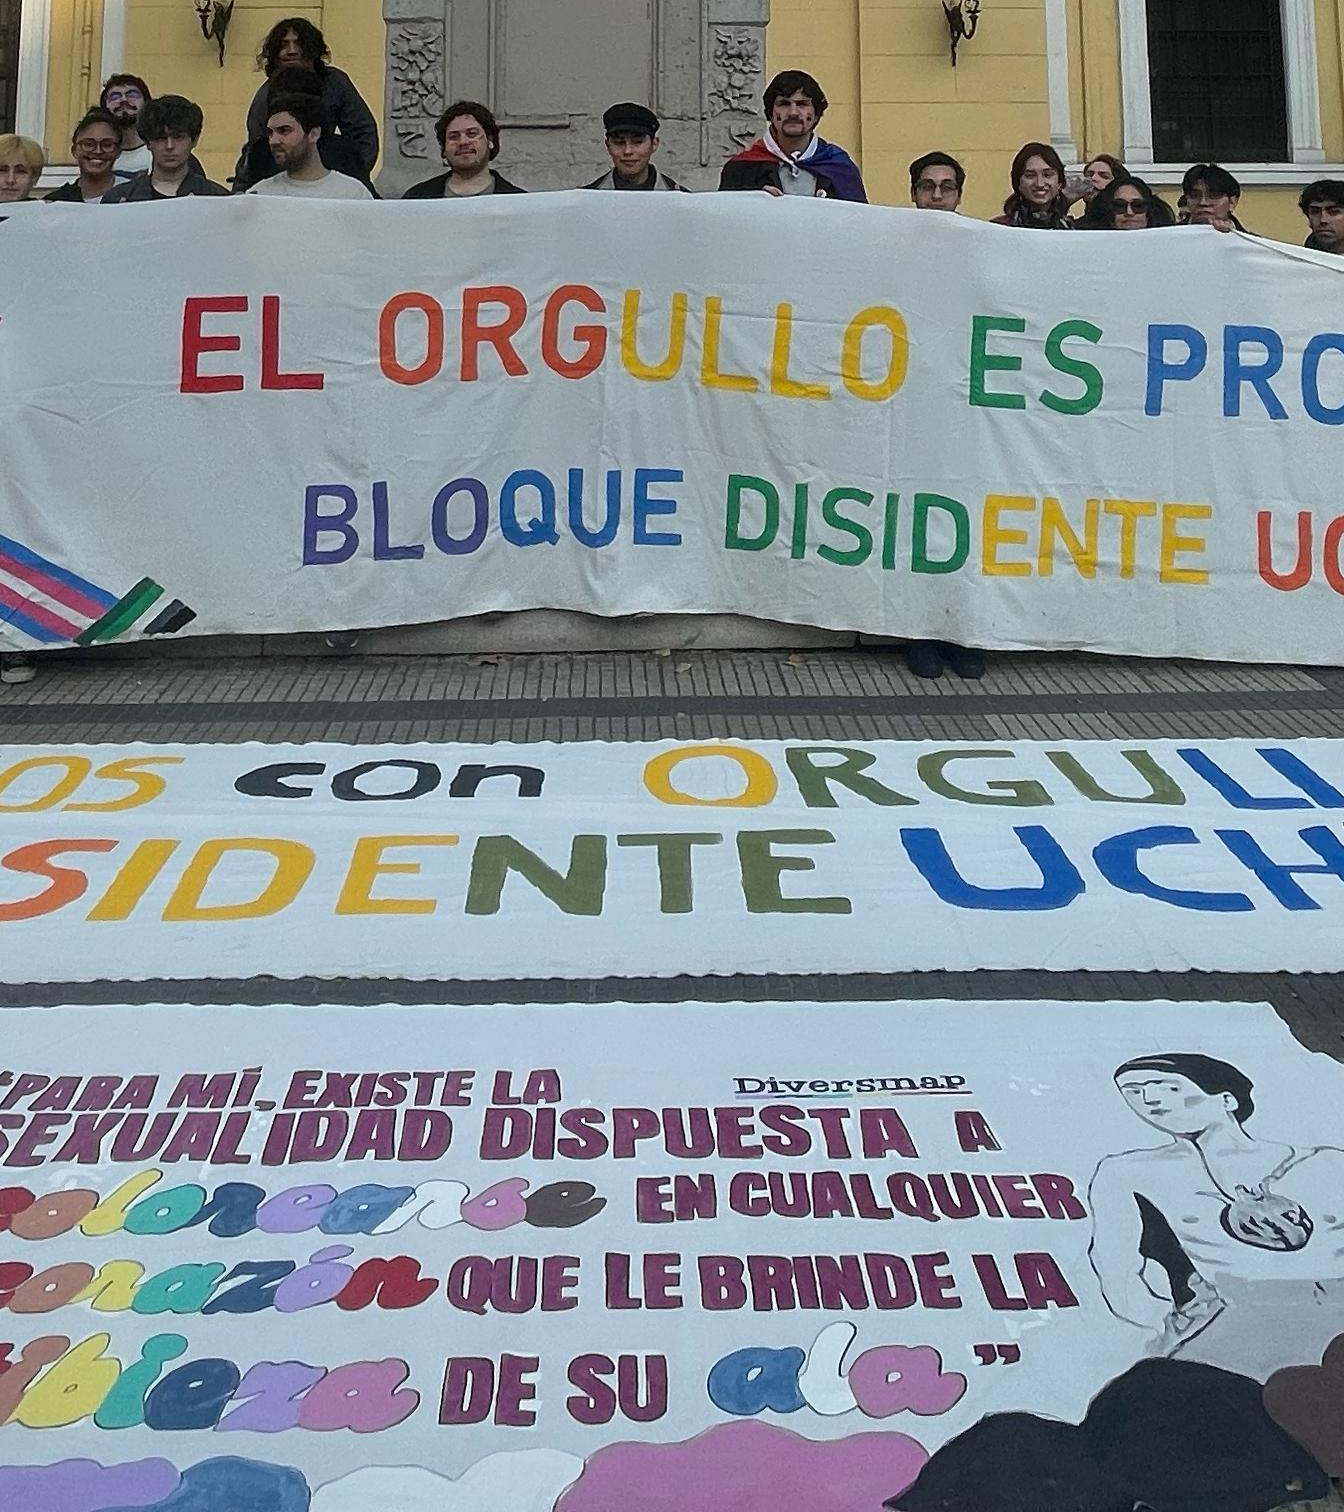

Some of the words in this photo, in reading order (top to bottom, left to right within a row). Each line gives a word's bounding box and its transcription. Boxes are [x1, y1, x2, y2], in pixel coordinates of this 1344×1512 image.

[180, 294, 324, 395] EL
[378, 285, 908, 402] ORGULLO
[969, 315, 1103, 416] ES
[302, 468, 684, 566] BLOQUE
[725, 473, 1211, 585] DISIDENTE
[234, 758, 545, 800] con
[278, 1069, 476, 1111] EXISTE
[490, 1068, 563, 1109] LA
[732, 1074, 967, 1094] Diversmap
[478, 1104, 920, 1161] DISPUESTA
[954, 1110, 1003, 1152] A
[635, 1173, 717, 1224] EN
[729, 1171, 1088, 1222] CUALQUIER
[446, 1254, 581, 1316] QUE
[604, 1251, 684, 1310] LE
[697, 1251, 963, 1312] BRINDE
[971, 1252, 1081, 1311] LA
[438, 1354, 540, 1427] DE
[565, 1354, 668, 1424] SU
